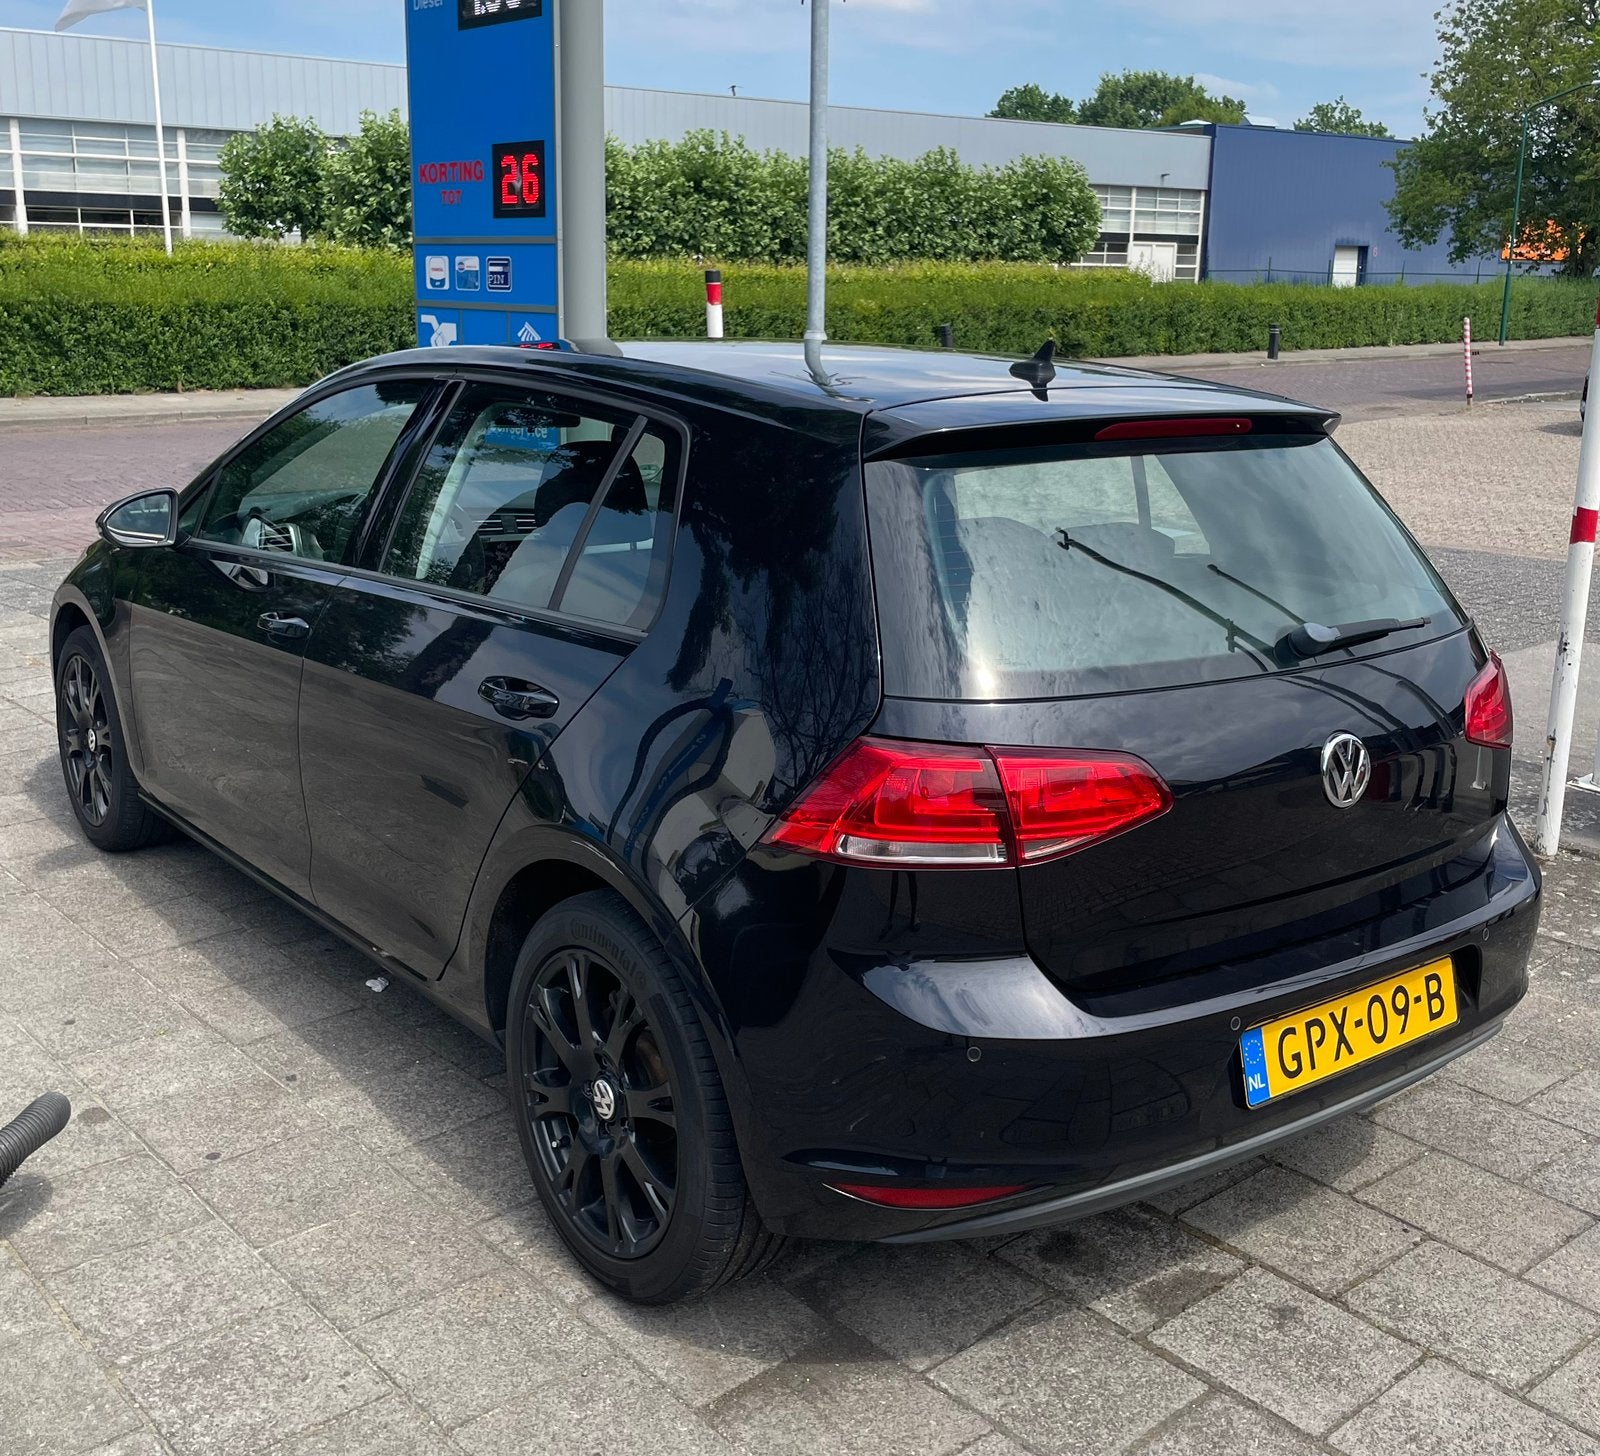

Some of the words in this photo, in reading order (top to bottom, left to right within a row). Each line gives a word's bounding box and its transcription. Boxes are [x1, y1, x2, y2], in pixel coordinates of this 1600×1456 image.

[419, 160, 484, 184] KORTING
[501, 153, 540, 205] 26
[441, 190, 462, 205] TOT
[488, 274, 505, 285] PIN
[1277, 972, 1446, 1080] GPX-09-B
[1248, 1073, 1266, 1092] NL
